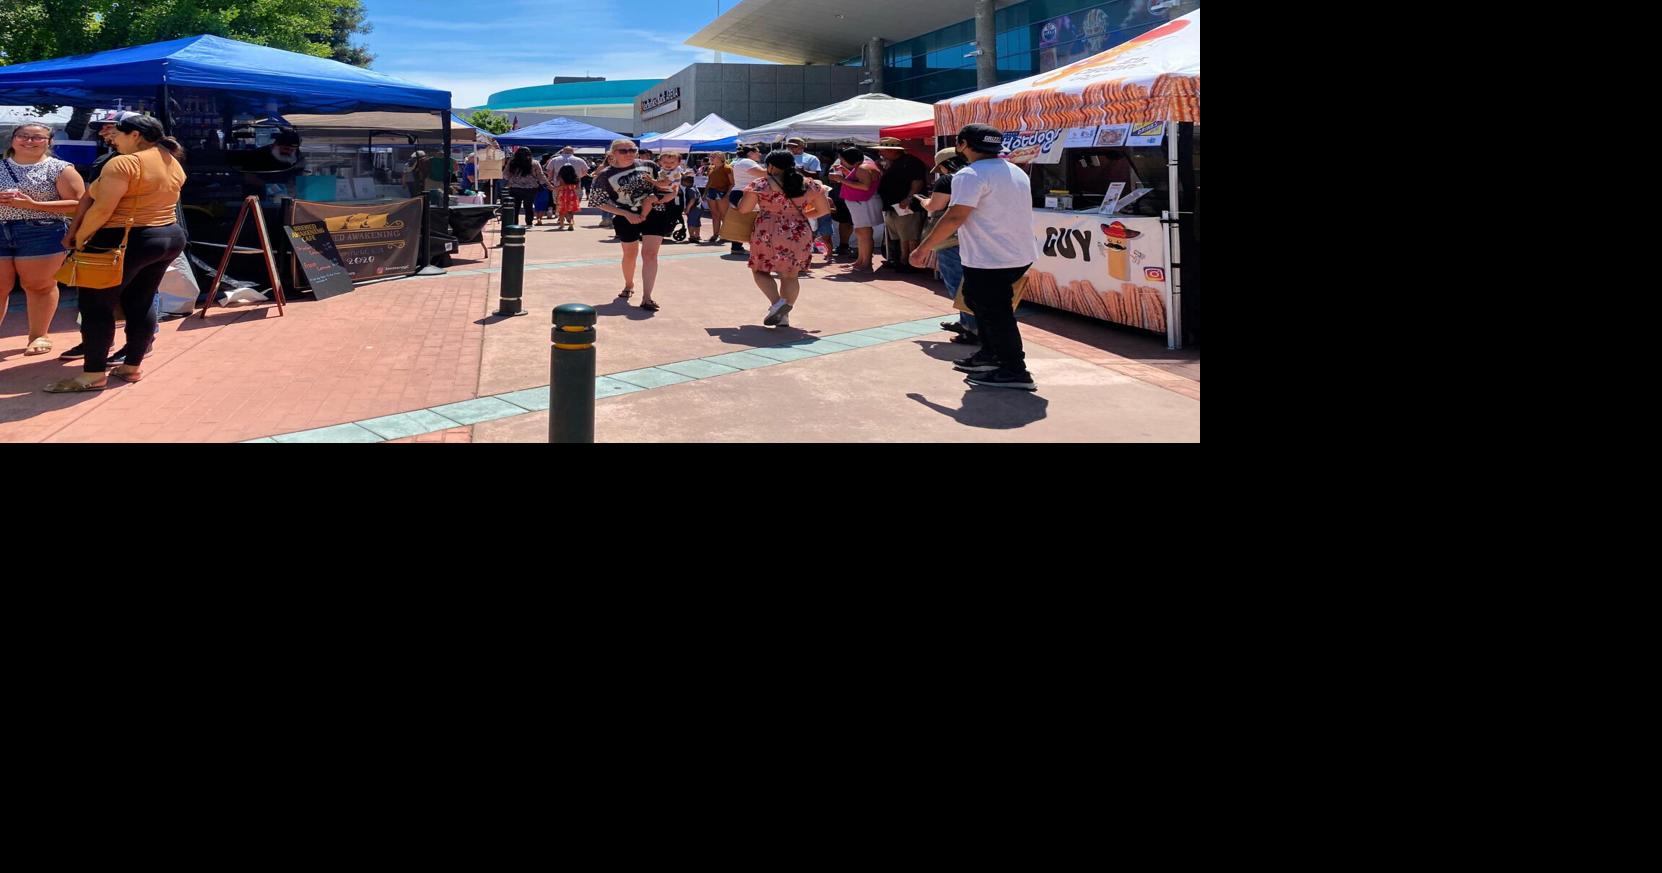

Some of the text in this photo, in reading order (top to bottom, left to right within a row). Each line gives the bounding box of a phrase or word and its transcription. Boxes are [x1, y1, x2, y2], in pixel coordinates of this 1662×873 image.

[347, 230, 401, 241] AWAKENING
[1043, 227, 1092, 262] GUY
[347, 255, 375, 265] 2020
